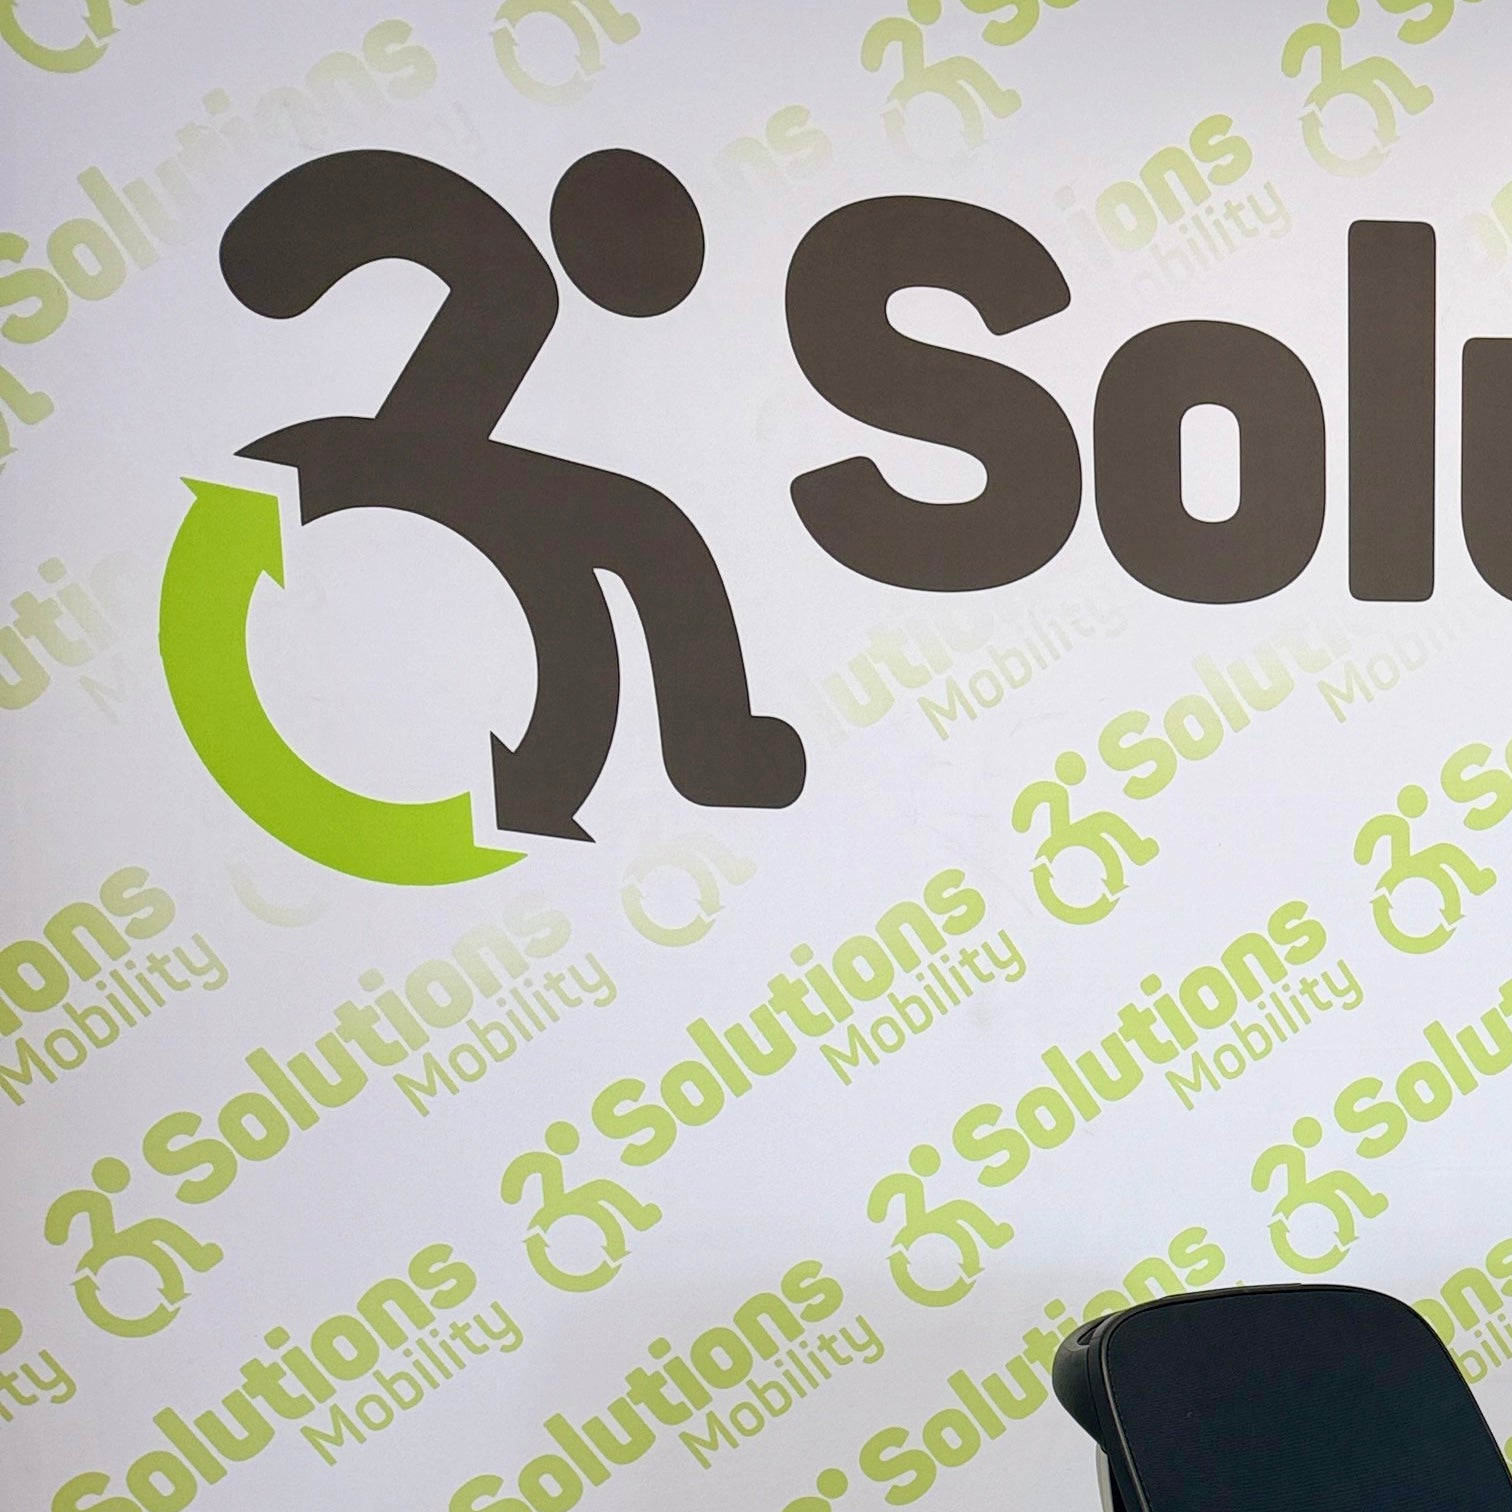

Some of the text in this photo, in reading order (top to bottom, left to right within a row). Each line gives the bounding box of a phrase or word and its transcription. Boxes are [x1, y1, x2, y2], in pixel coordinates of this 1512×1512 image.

[142, 890, 571, 1204] Solutions
[392, 952, 618, 1117] Mobility
[592, 868, 986, 1167] Solutions
[819, 929, 1027, 1086] Mobility
[952, 900, 1327, 1187] Solutions
[1163, 958, 1365, 1111] Mobility
[300, 1301, 524, 1467] Mobility
[678, 1314, 886, 1470] Mobility
